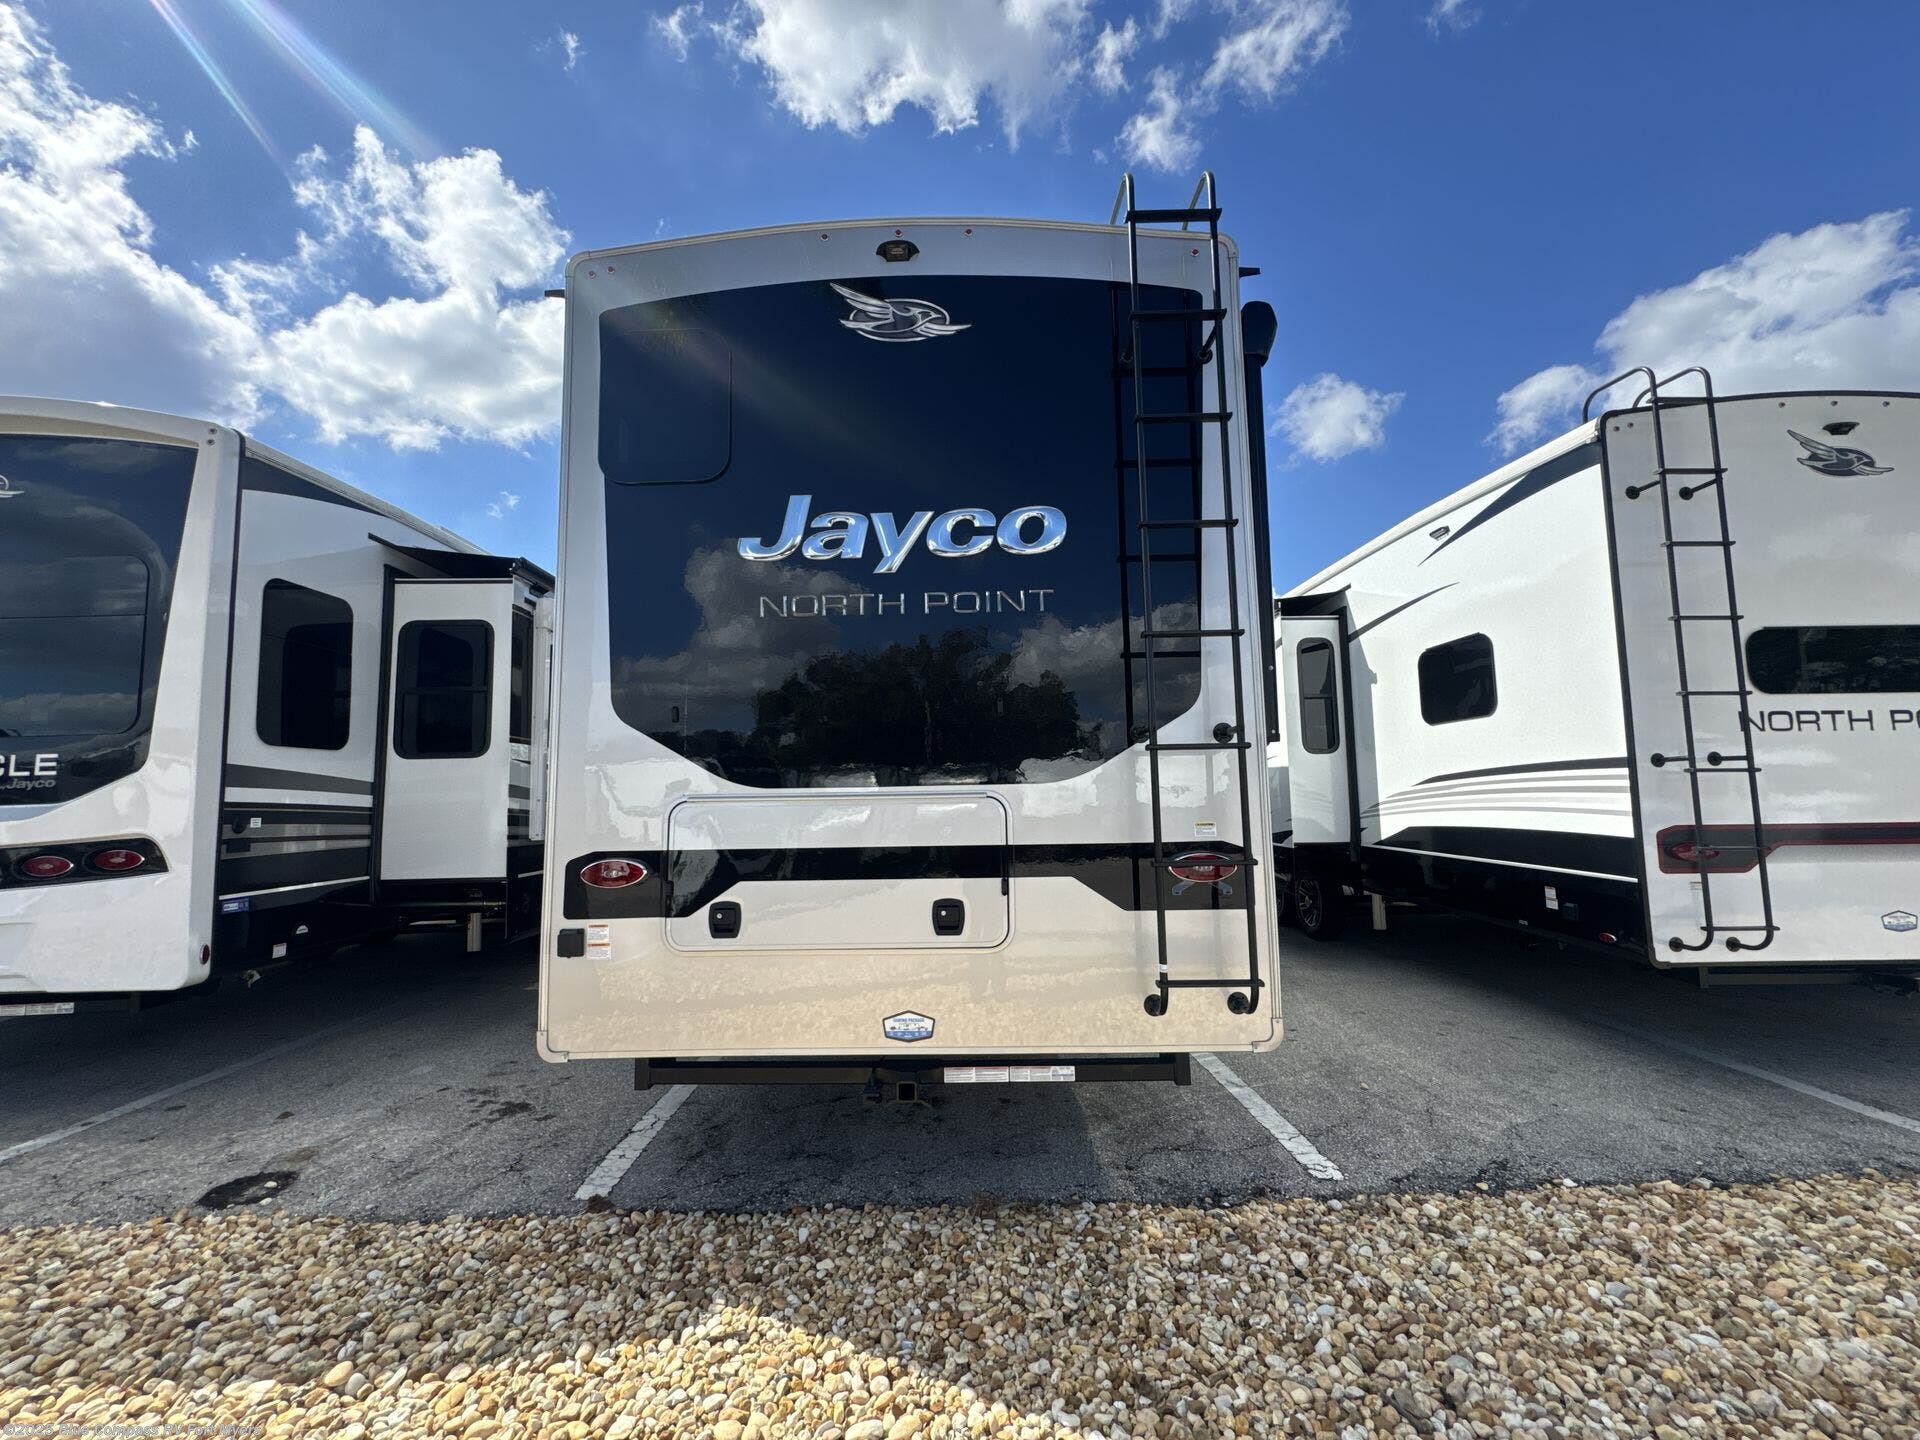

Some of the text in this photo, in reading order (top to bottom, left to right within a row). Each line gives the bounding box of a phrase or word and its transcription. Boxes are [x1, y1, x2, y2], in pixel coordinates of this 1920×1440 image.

[737, 494, 1067, 574] Jayco
[760, 588, 1055, 618] NORTH POINT
[1738, 709, 1920, 732] NORTH P
[0, 753, 59, 777] LE
